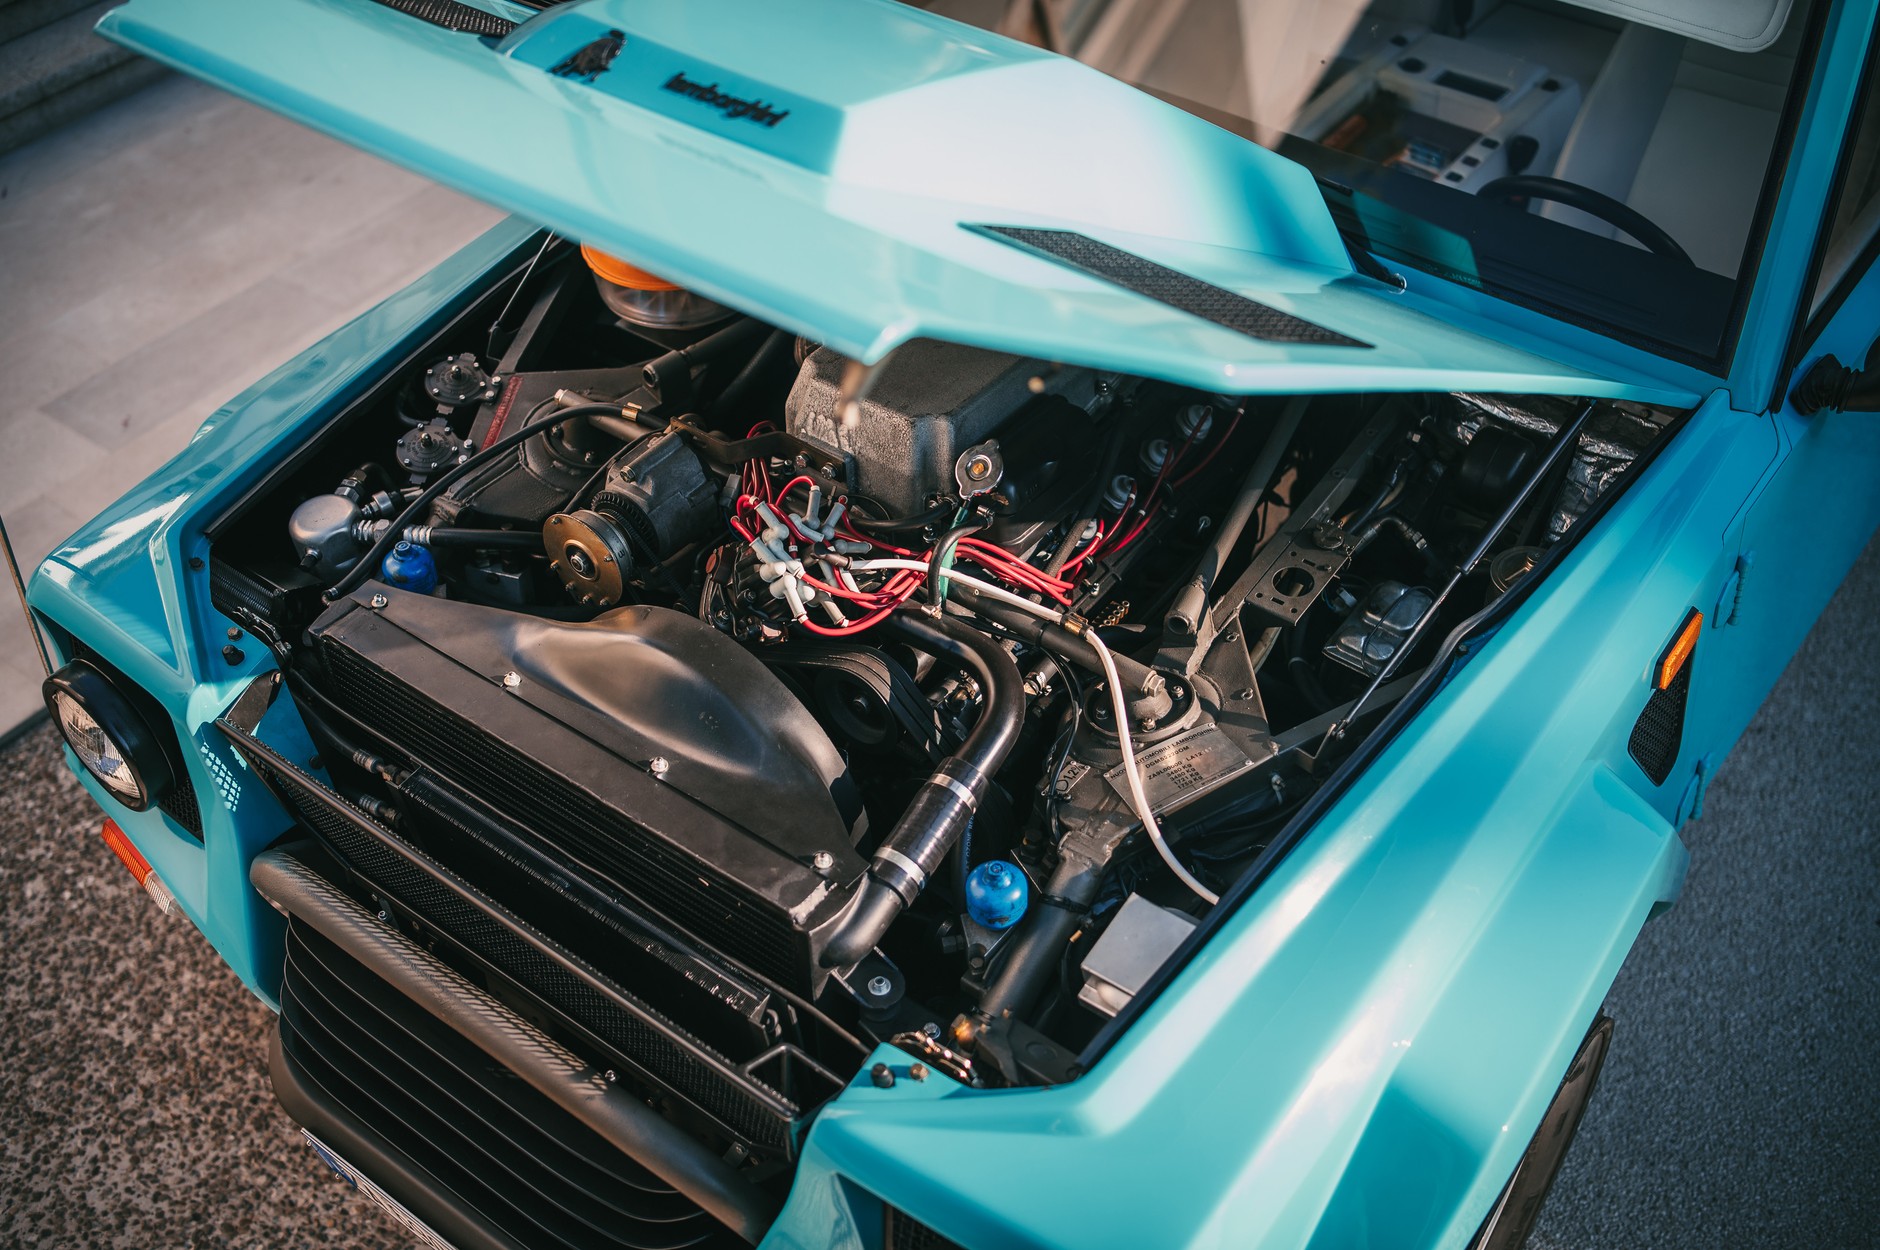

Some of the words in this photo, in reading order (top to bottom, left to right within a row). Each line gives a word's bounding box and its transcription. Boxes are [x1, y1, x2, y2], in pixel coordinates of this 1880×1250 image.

[663, 71, 789, 127] lamborghini
[1171, 727, 1214, 747] LAMBORGHINI
[1182, 763, 1193, 771] Kg
[1174, 776, 1190, 785] 1721
